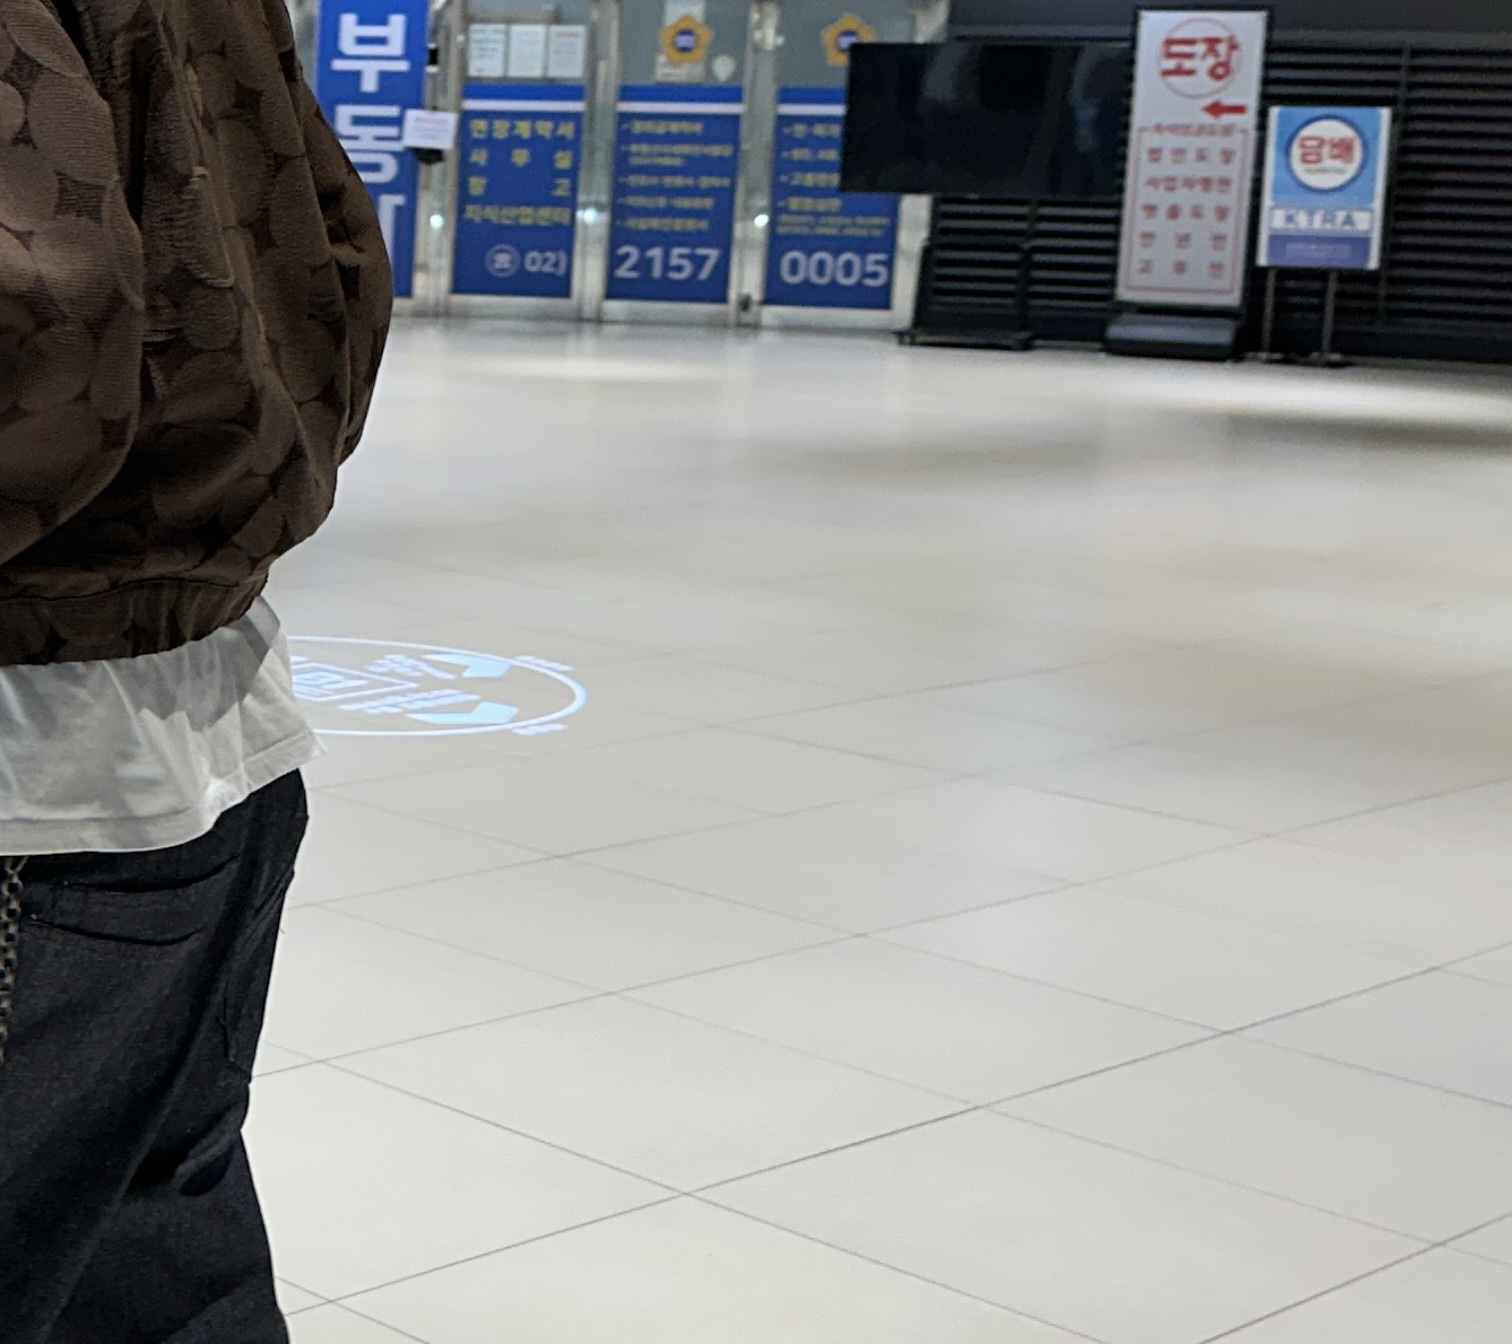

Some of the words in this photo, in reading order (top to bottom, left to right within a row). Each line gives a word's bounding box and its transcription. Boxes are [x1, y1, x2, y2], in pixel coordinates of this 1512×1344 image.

[1160, 35, 1239, 81] 도장
[330, 13, 410, 264] 부동
[1299, 137, 1356, 164] 담배
[524, 250, 568, 277] 02)
[614, 244, 721, 281] 2157
[780, 249, 888, 288] 0005
